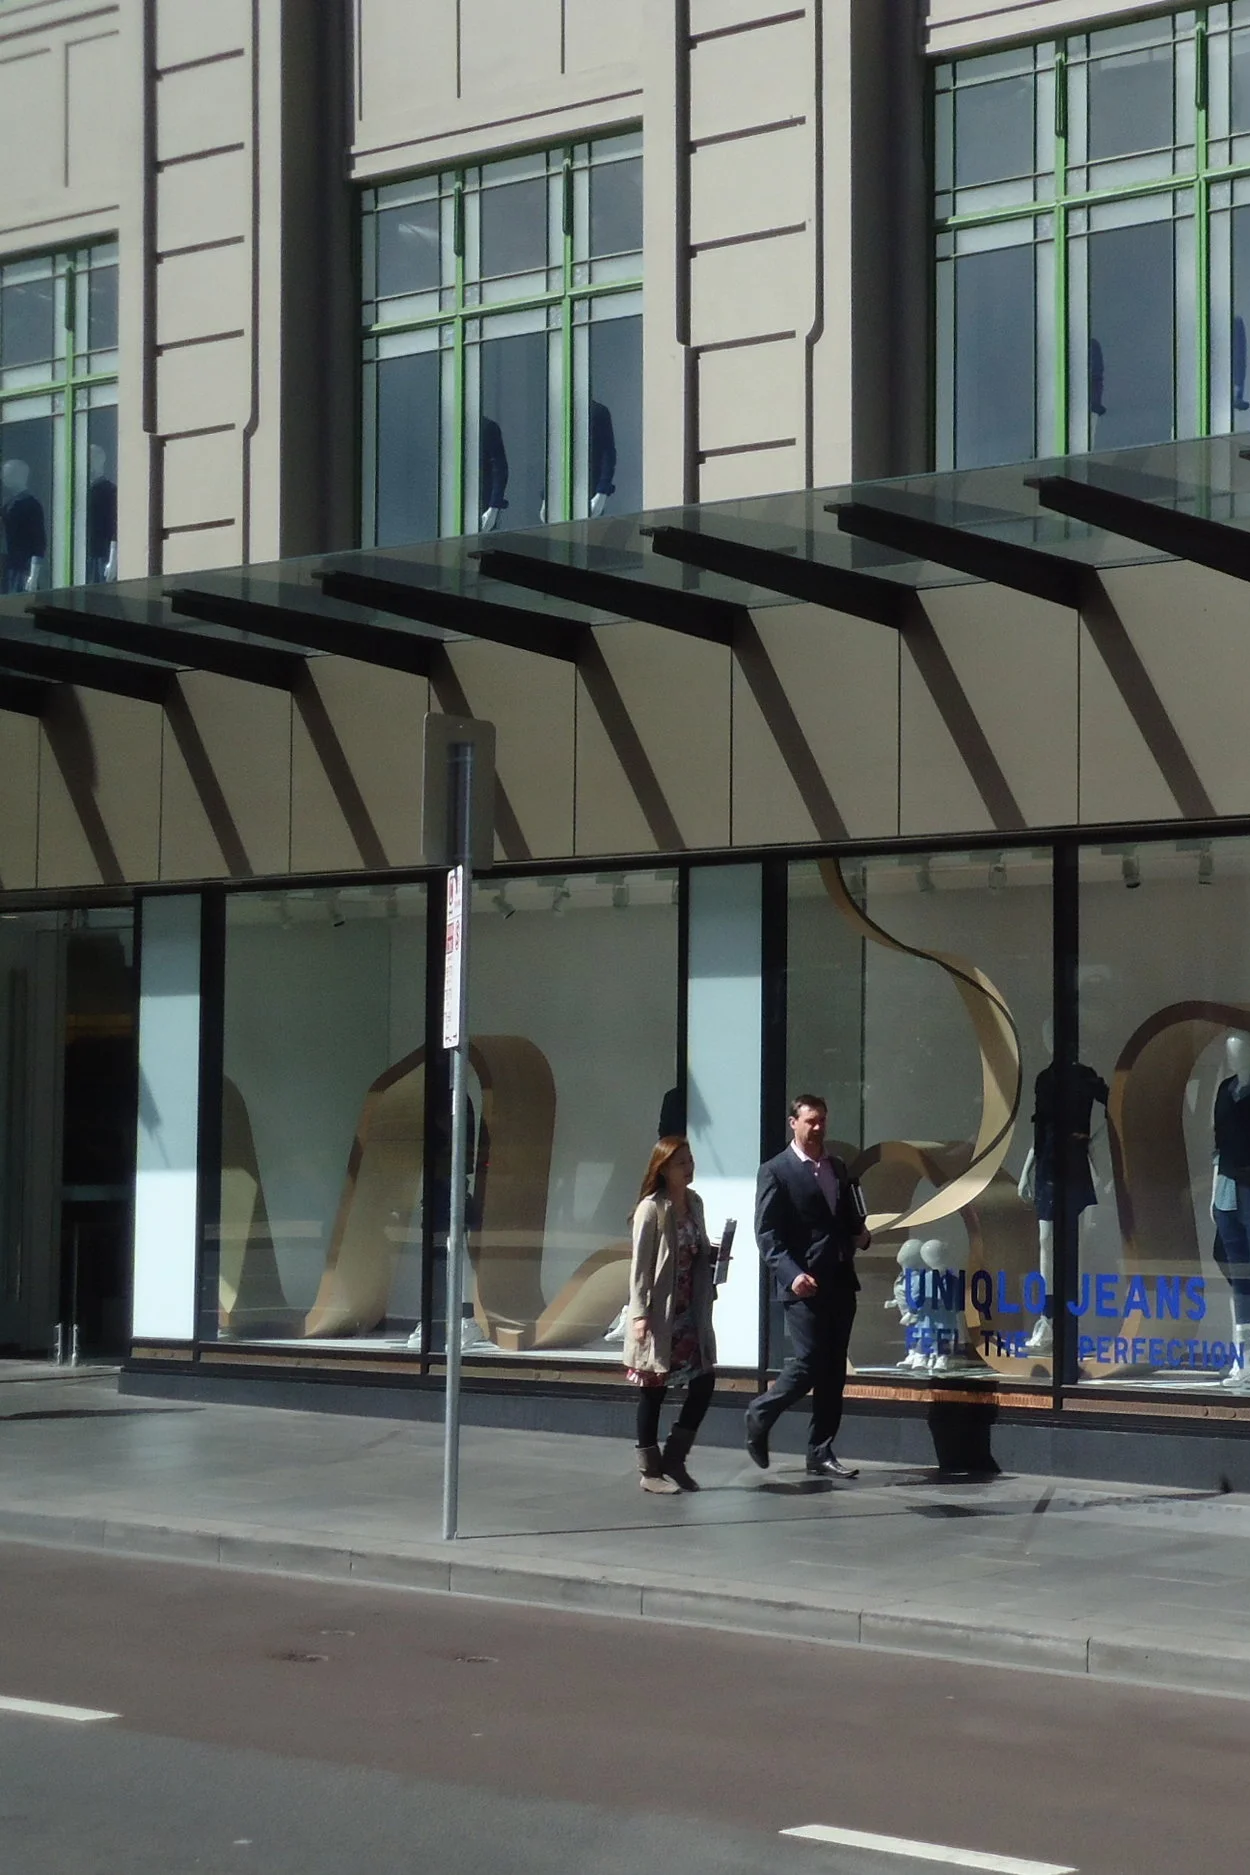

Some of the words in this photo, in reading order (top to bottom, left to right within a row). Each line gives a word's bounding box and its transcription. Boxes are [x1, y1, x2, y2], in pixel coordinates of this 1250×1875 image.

[905, 1267, 1046, 1321] UNIQLO
[1066, 1272, 1208, 1321] JEANS
[905, 1326, 960, 1356] FEEL
[980, 1329, 1030, 1358] THE
[1078, 1334, 1245, 1369] PERFECTION
